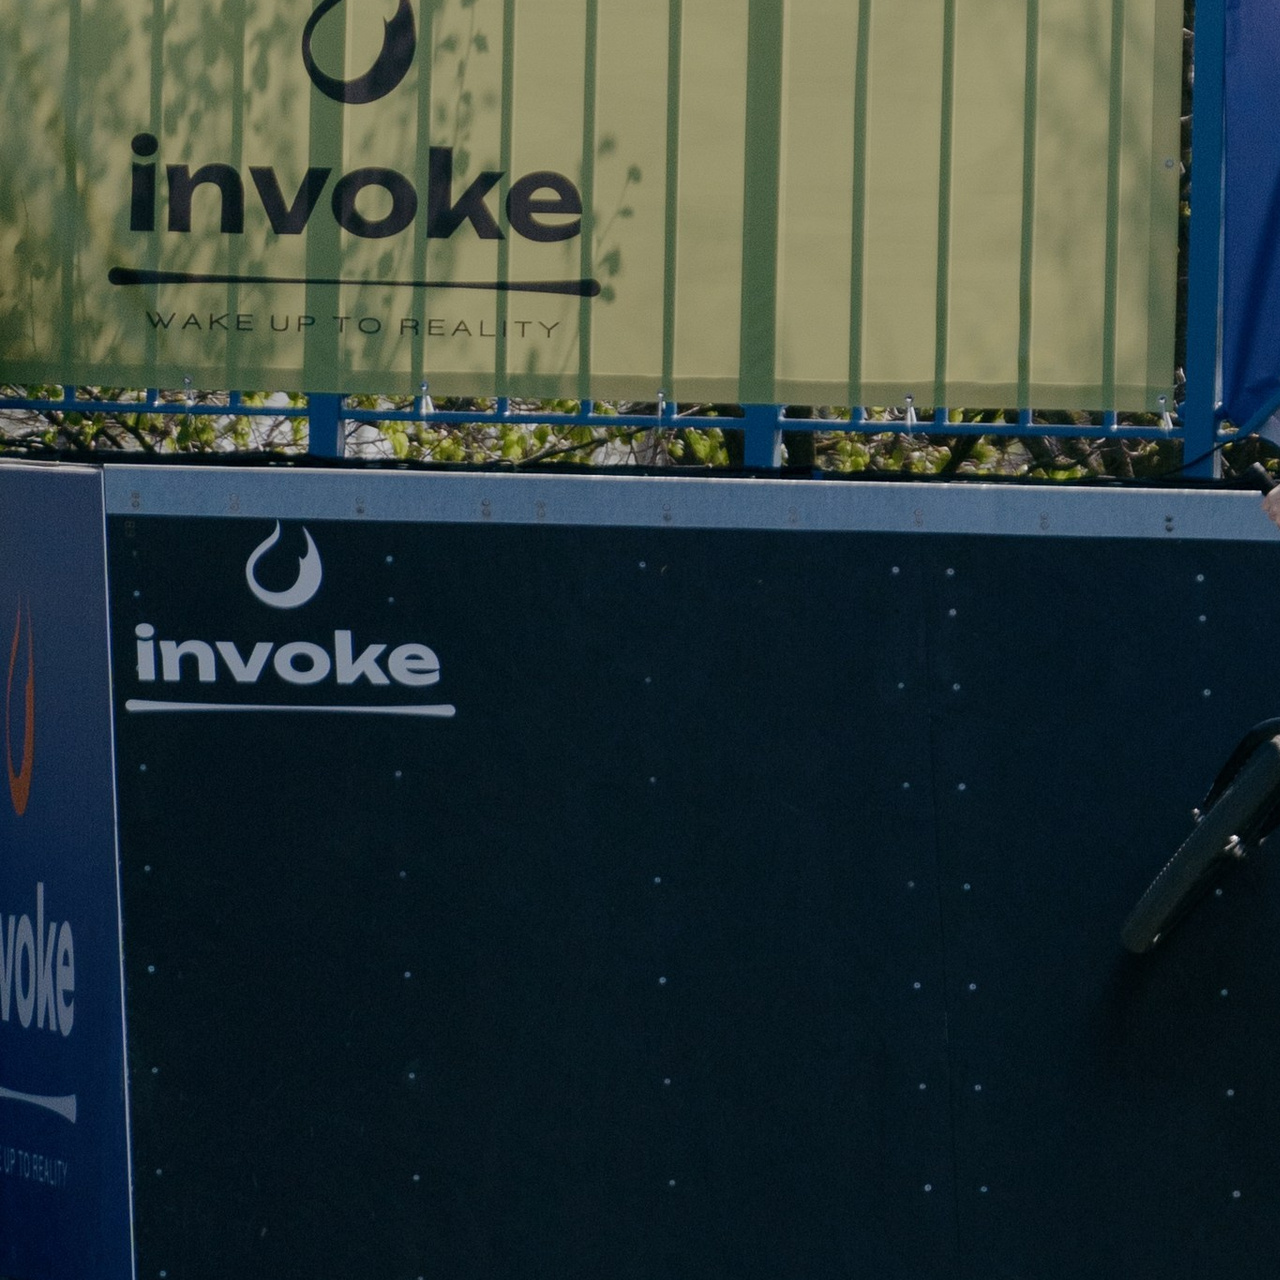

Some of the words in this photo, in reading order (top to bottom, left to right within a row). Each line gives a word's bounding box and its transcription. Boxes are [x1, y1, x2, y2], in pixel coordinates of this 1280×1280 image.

[129, 133, 583, 243] invoke
[146, 311, 254, 332] WAKE
[270, 314, 316, 332] UP
[333, 316, 382, 335] TO
[400, 318, 560, 339] REALITY
[135, 623, 440, 686] invoke
[3, 1146, 16, 1174] UP
[18, 1149, 30, 1179] TO
[32, 1153, 68, 1187] REALITY
